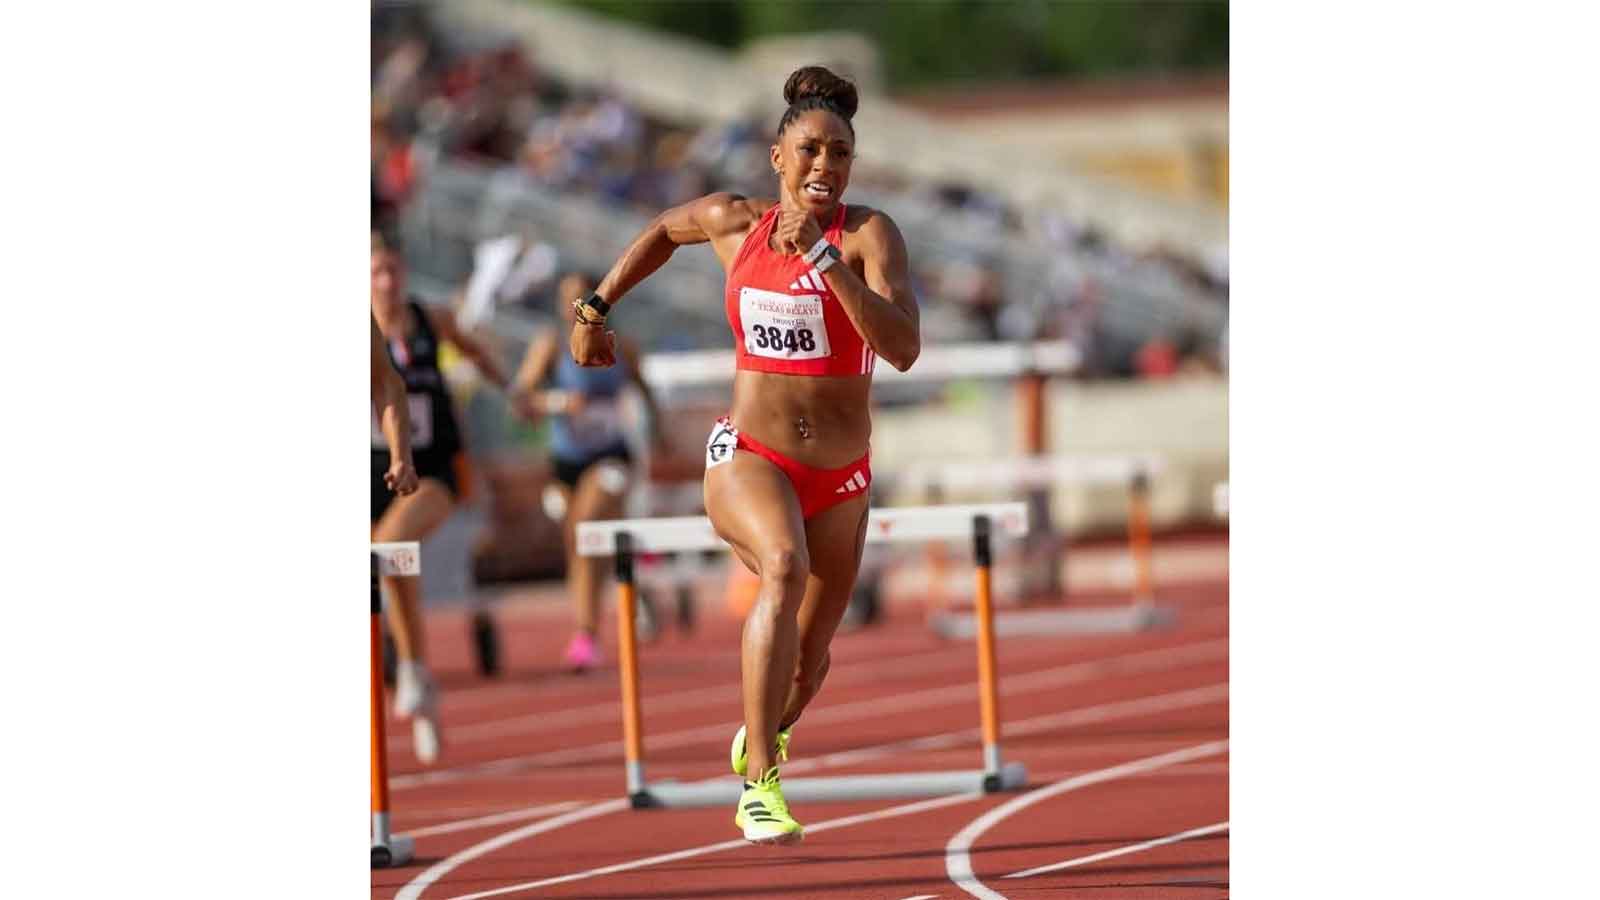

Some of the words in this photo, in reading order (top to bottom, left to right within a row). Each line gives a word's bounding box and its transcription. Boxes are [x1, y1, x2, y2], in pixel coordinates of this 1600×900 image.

[758, 303, 784, 313] TEXAS
[786, 307, 819, 315] RELAYS
[753, 324, 815, 352] 3848
